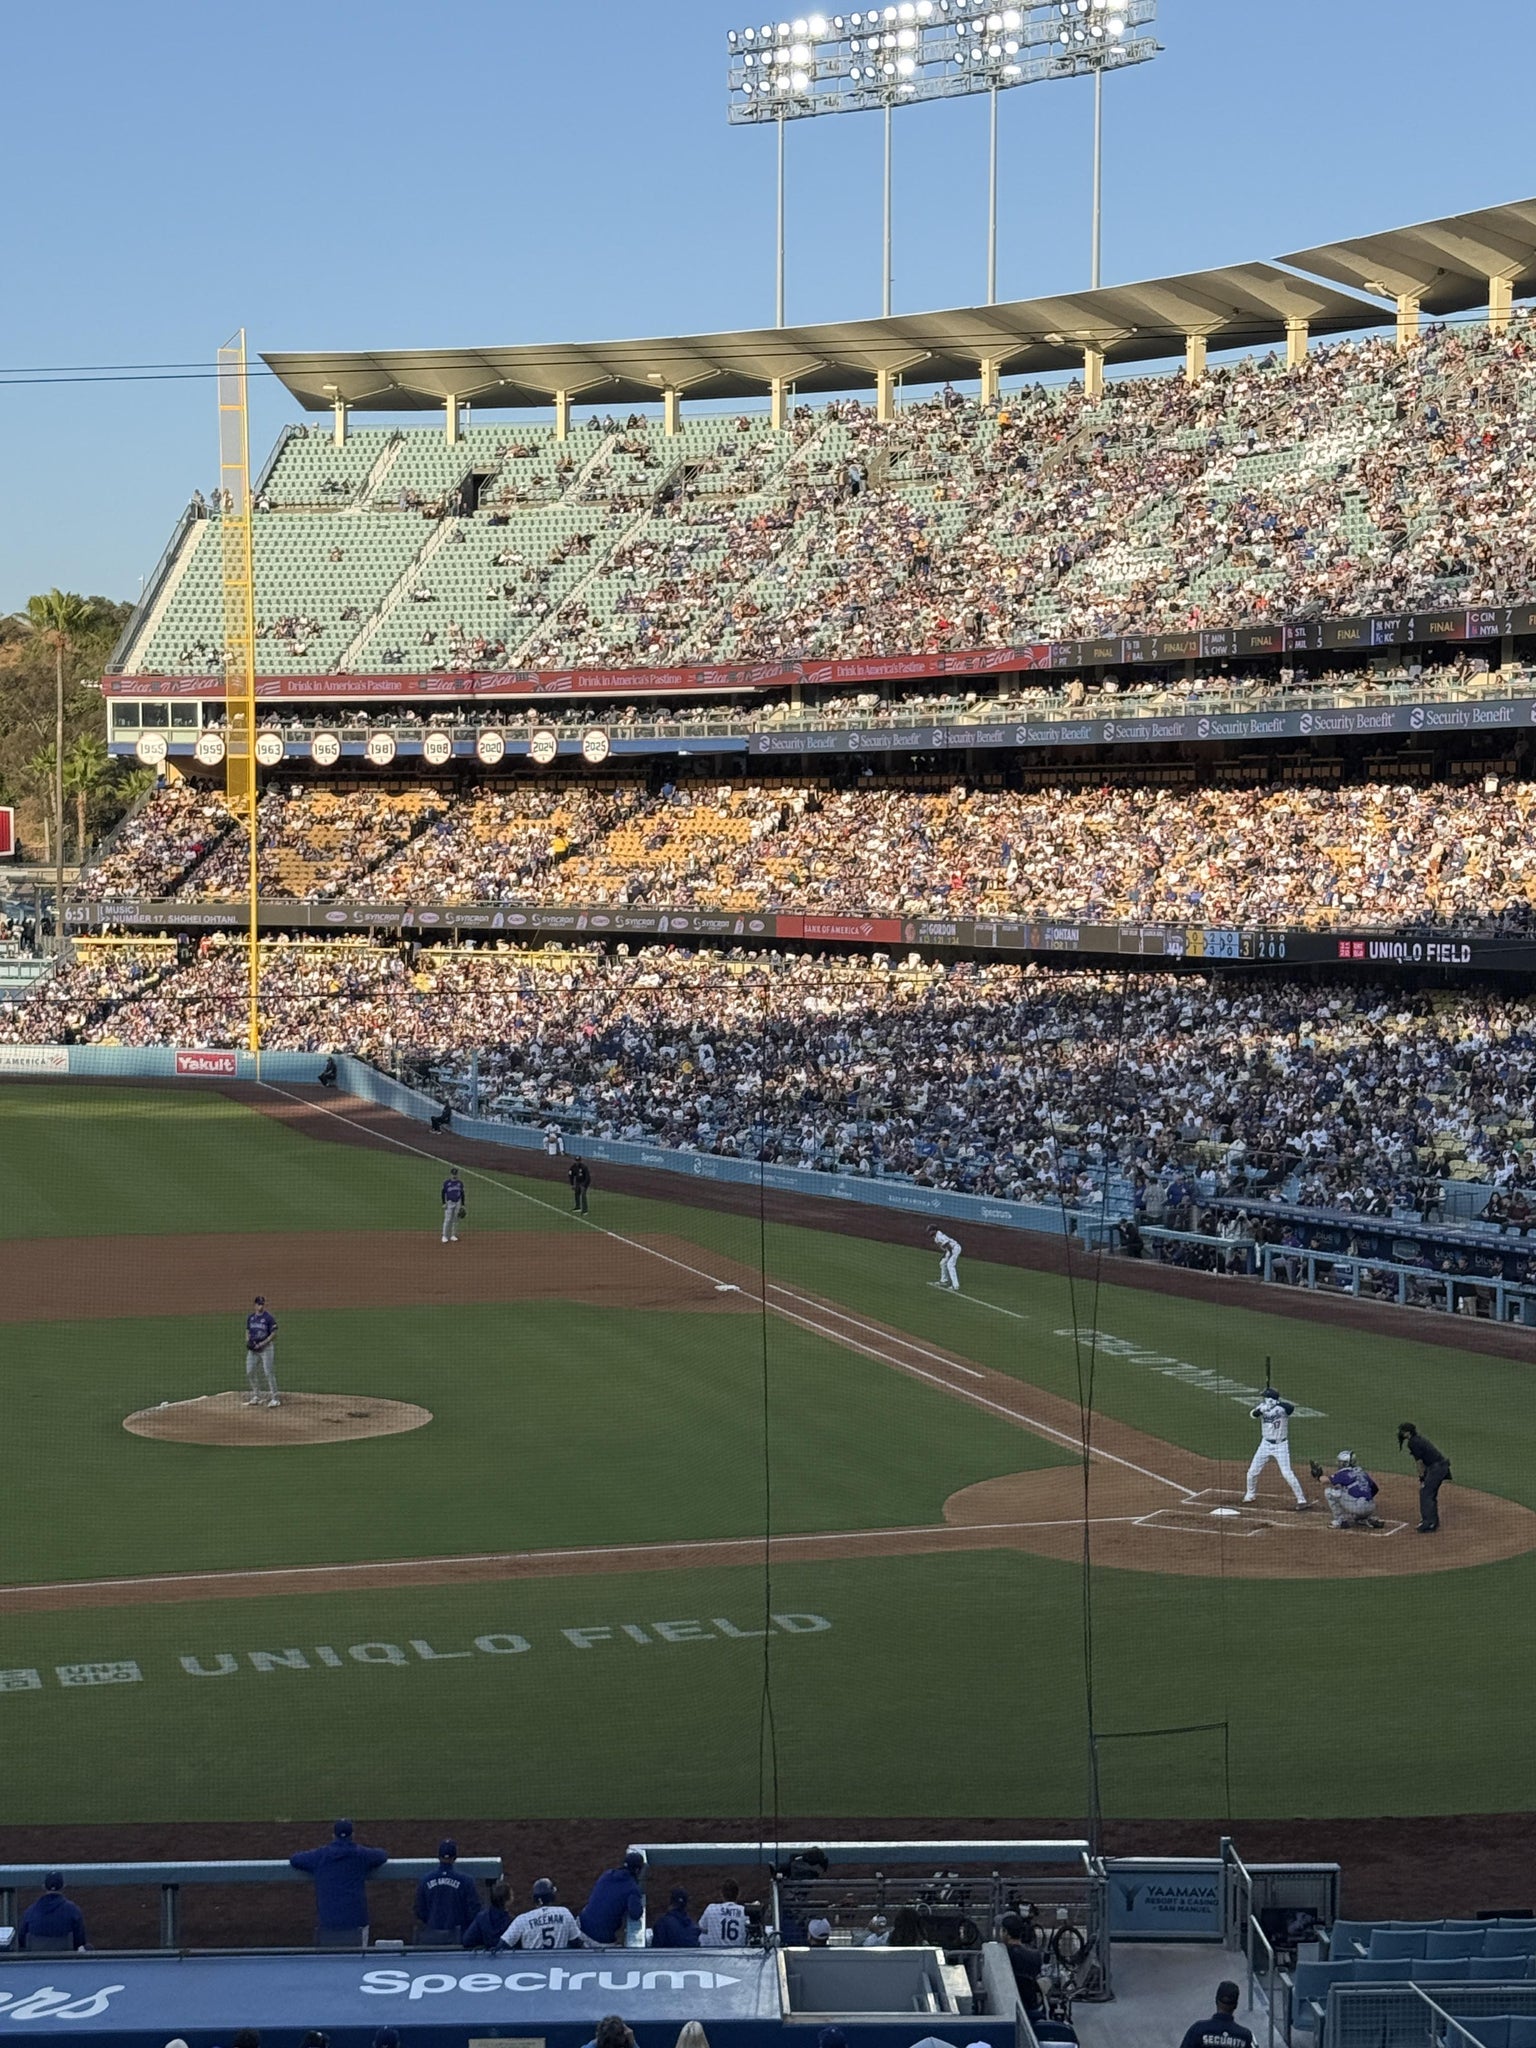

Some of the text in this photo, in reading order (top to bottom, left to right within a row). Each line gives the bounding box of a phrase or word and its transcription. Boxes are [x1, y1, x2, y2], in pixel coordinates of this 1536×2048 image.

[1480, 612, 1495, 622] CIN
[1505, 611, 1513, 621] 7
[1384, 618, 1414, 630] NYY 4
[1429, 622, 1455, 633] FINAL
[1480, 625, 1498, 636] NYM
[1505, 623, 1512, 634] 2
[1295, 626, 1322, 637] STL 1
[1337, 629, 1360, 640] FINAL
[1384, 631, 1414, 642] KC 3
[1151, 639, 1158, 649] 7
[1211, 632, 1237, 644] MIN 1
[1251, 637, 1272, 647] FINAL
[1316, 638, 1322, 648] 5
[1078, 645, 1082, 655] 1
[1094, 648, 1113, 658] FINAL
[1163, 642, 1197, 655] FINAL/13
[1211, 644, 1238, 655] CHW 3
[1151, 650, 1158, 660] 9
[1077, 657, 1082, 666] 2
[838, 667, 856, 678] Drink
[898, 661, 926, 673] Pastime
[288, 679, 402, 691] Drink in America's Pastime
[578, 676, 598, 687] Drink
[611, 674, 650, 686] America's
[650, 673, 682, 685] Pastime
[1314, 715, 1355, 732] Security
[1426, 709, 1470, 727] Security
[1116, 725, 1151, 740] Security
[1211, 718, 1249, 737] Security
[860, 734, 892, 749] Security
[944, 730, 976, 746] Security
[1028, 728, 1060, 743] Security
[140, 743, 164, 755] 1955
[199, 744, 223, 755] 1959
[257, 744, 281, 755] 1963
[314, 744, 338, 755] 1965
[371, 743, 393, 755] 1981
[480, 742, 502, 754] 2020
[533, 741, 554, 753] 2024
[585, 740, 606, 752] 2025
[772, 736, 805, 752] Security
[65, 907, 90, 921] 6:51
[112, 915, 151, 923] NUMBER
[168, 915, 201, 923] SHOHEI
[822, 925, 830, 933] OF
[830, 925, 860, 935] AMERICA
[929, 923, 957, 936] GORDON
[1053, 928, 1080, 941] OHTANI
[1192, 932, 1198, 942] 0
[1209, 933, 1215, 943] 2
[1227, 933, 1233, 943] 0
[1193, 945, 1197, 955] 1
[1209, 946, 1215, 956] 3
[1243, 941, 1250, 956] 3
[1259, 942, 1285, 958] 2 0 0
[1369, 941, 1422, 964] UNIQLO
[1426, 943, 1471, 963] FIELD
[6, 1058, 46, 1066] AMERICA
[178, 1056, 235, 1072] Yakult
[180, 1611, 833, 1677] UNIQLO FIELD
[528, 1913, 564, 1930] FREEMAN
[720, 1917, 740, 1941] 16
[541, 1926, 555, 1949] 5
[359, 1966, 714, 2000] Spectrum
[1202, 2034, 1246, 2048] SECURITY
